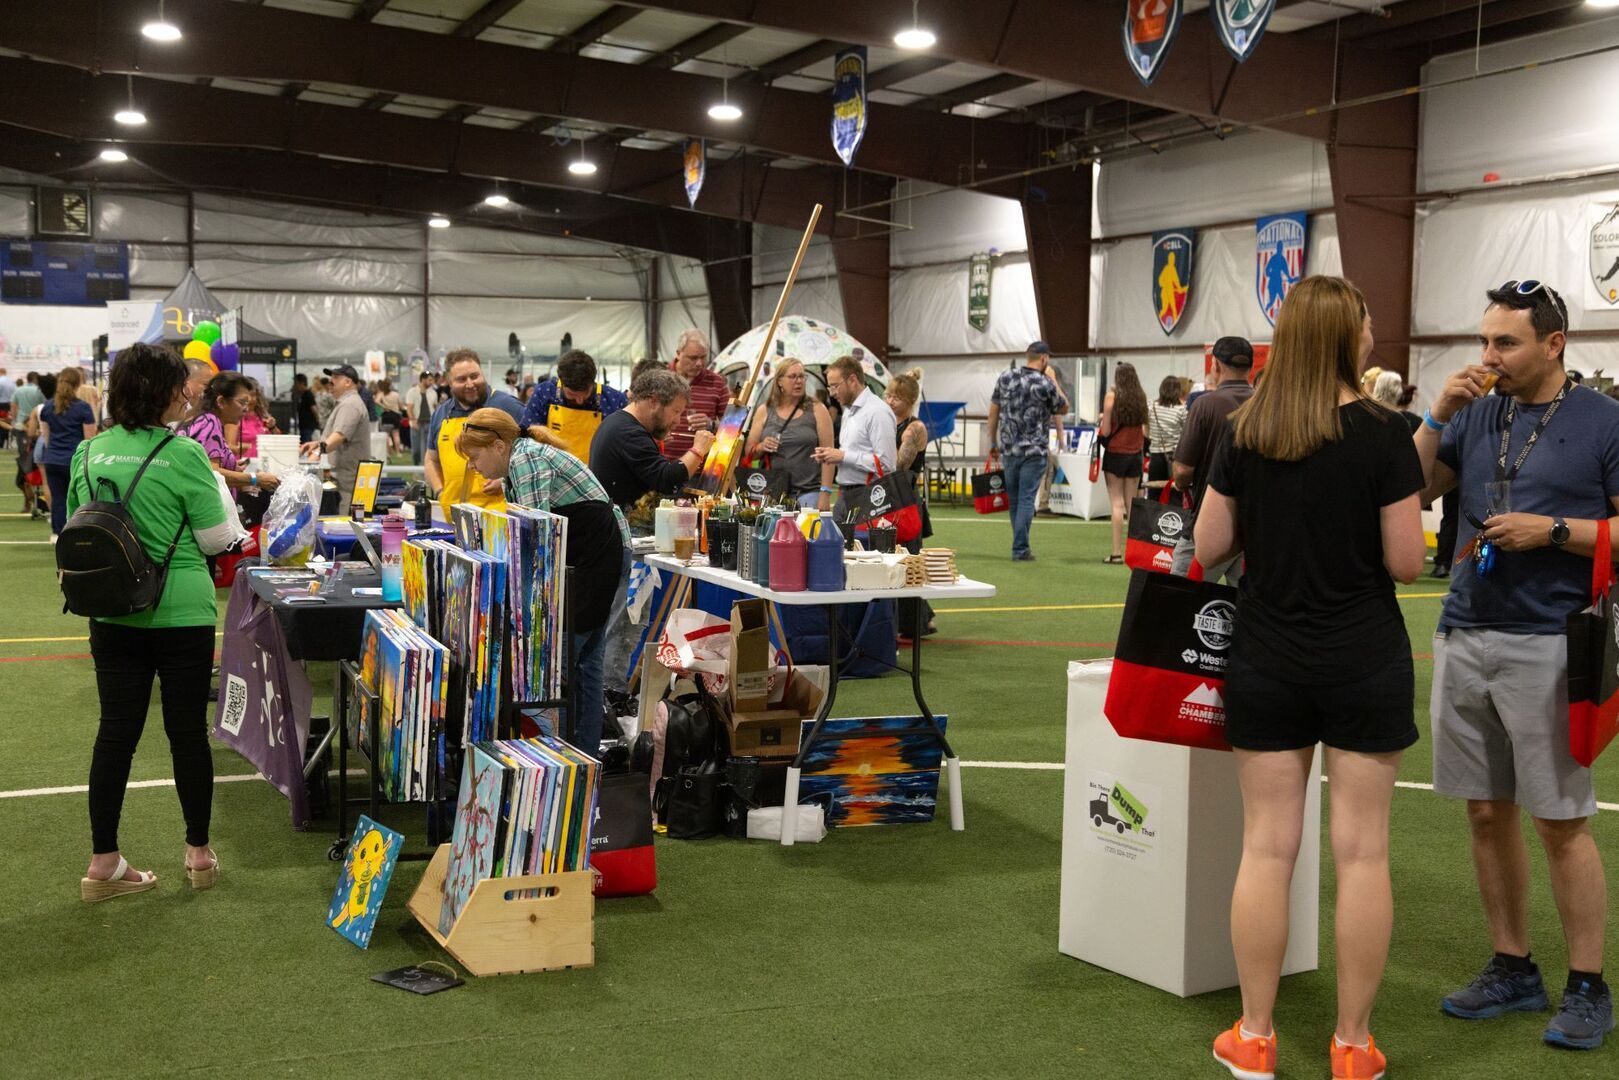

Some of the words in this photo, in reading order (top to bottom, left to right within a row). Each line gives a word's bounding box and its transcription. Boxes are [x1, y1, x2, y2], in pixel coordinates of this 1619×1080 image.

[1259, 222, 1302, 245] NATIONAL
[110, 320, 140, 328] balanced
[252, 346, 277, 354] RESIST
[116, 455, 170, 467] MARTIN/ARTIN
[1197, 616, 1217, 631] TASTE
[1221, 621, 1234, 633] WE
[1200, 652, 1228, 667] Weste
[1179, 707, 1226, 722] CHAMBER
[1111, 786, 1143, 825] Dump
[1141, 827, 1155, 838] That
[591, 836, 608, 845] erra
